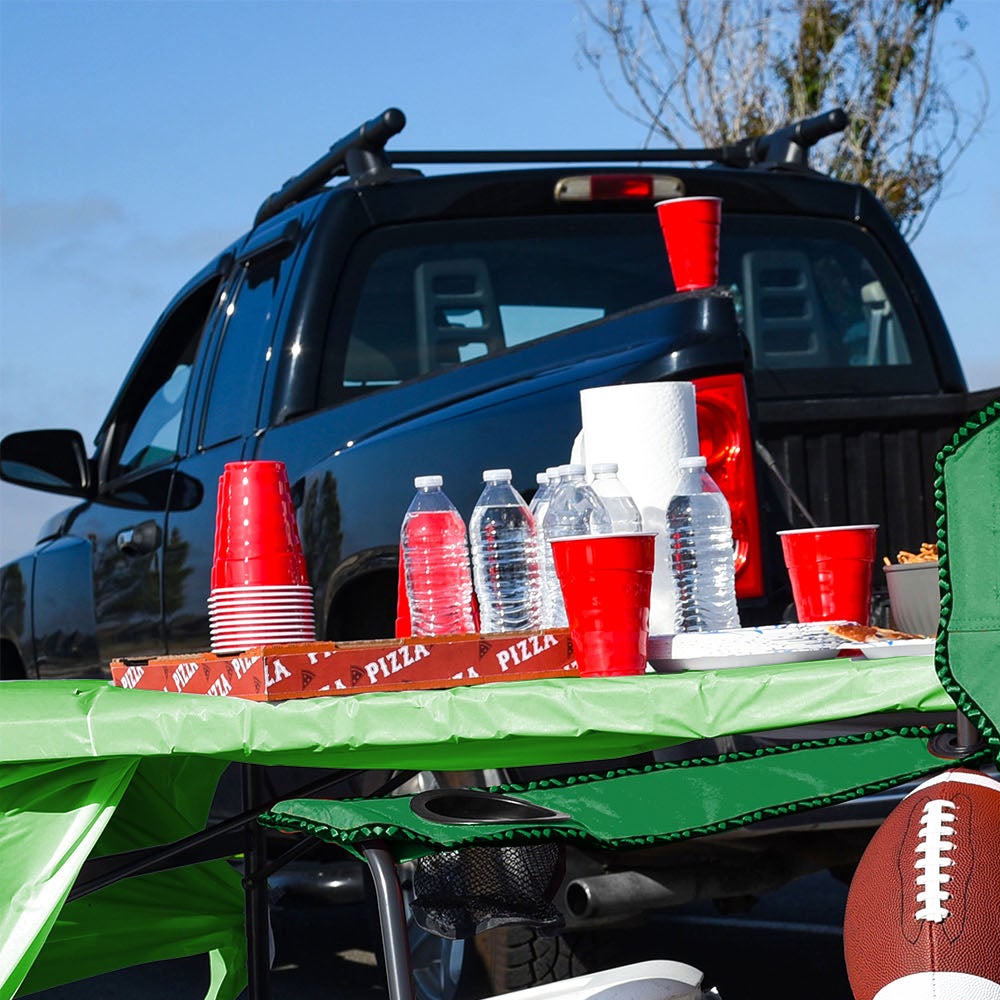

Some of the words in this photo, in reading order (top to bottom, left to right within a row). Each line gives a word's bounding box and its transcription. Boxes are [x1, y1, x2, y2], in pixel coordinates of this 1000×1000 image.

[364, 644, 430, 685] PIZZA
[496, 634, 559, 672] PIZZA
[172, 662, 199, 693] PIZZA
